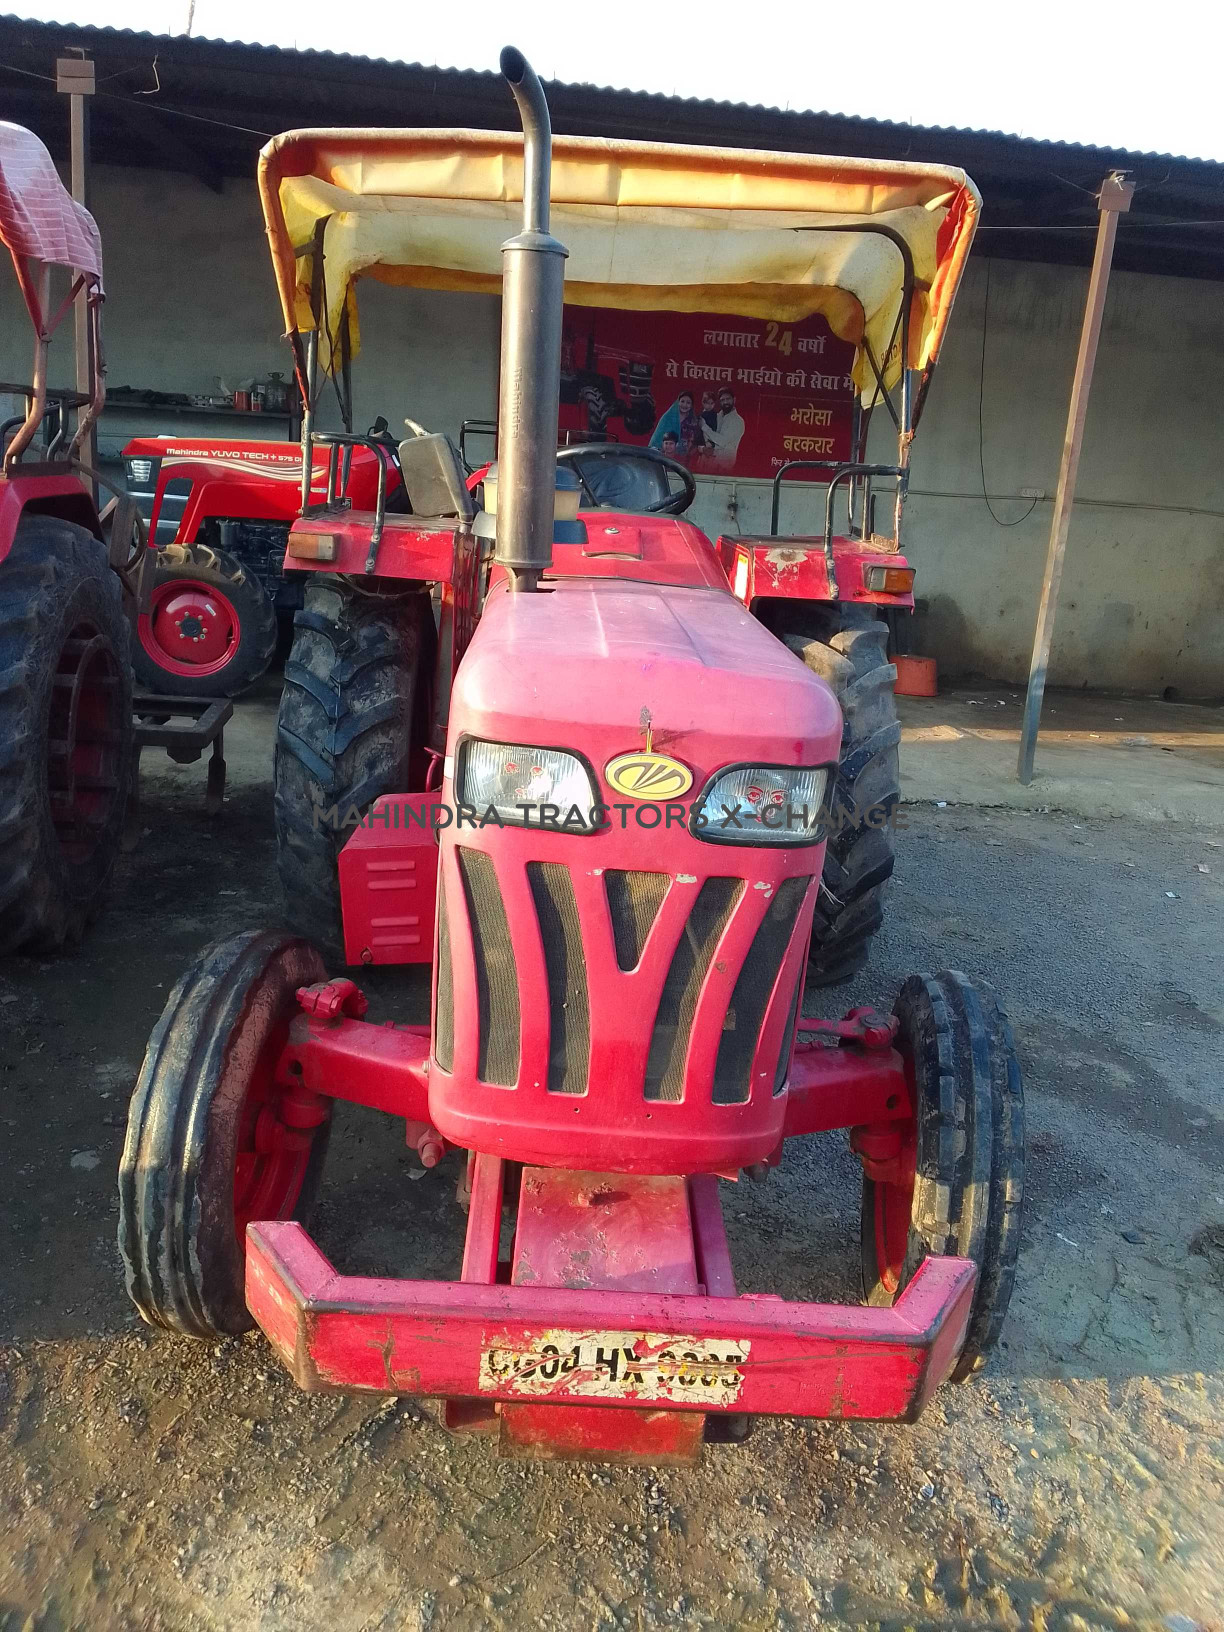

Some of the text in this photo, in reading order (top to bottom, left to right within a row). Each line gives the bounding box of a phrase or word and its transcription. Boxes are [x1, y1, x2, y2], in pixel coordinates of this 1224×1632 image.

[703, 329, 760, 348] लगातार
[764, 321, 793, 356] 24
[665, 358, 680, 378] से
[683, 360, 734, 382] किसान
[737, 366, 783, 386] भाईयो
[786, 369, 807, 388] की
[810, 370, 840, 390] सेवा
[790, 403, 833, 427] भरोसा
[166, 448, 208, 456] Mahindra
[210, 450, 240, 458] YUVO
[242, 452, 269, 460] TECH
[783, 435, 835, 455] बरकरार
